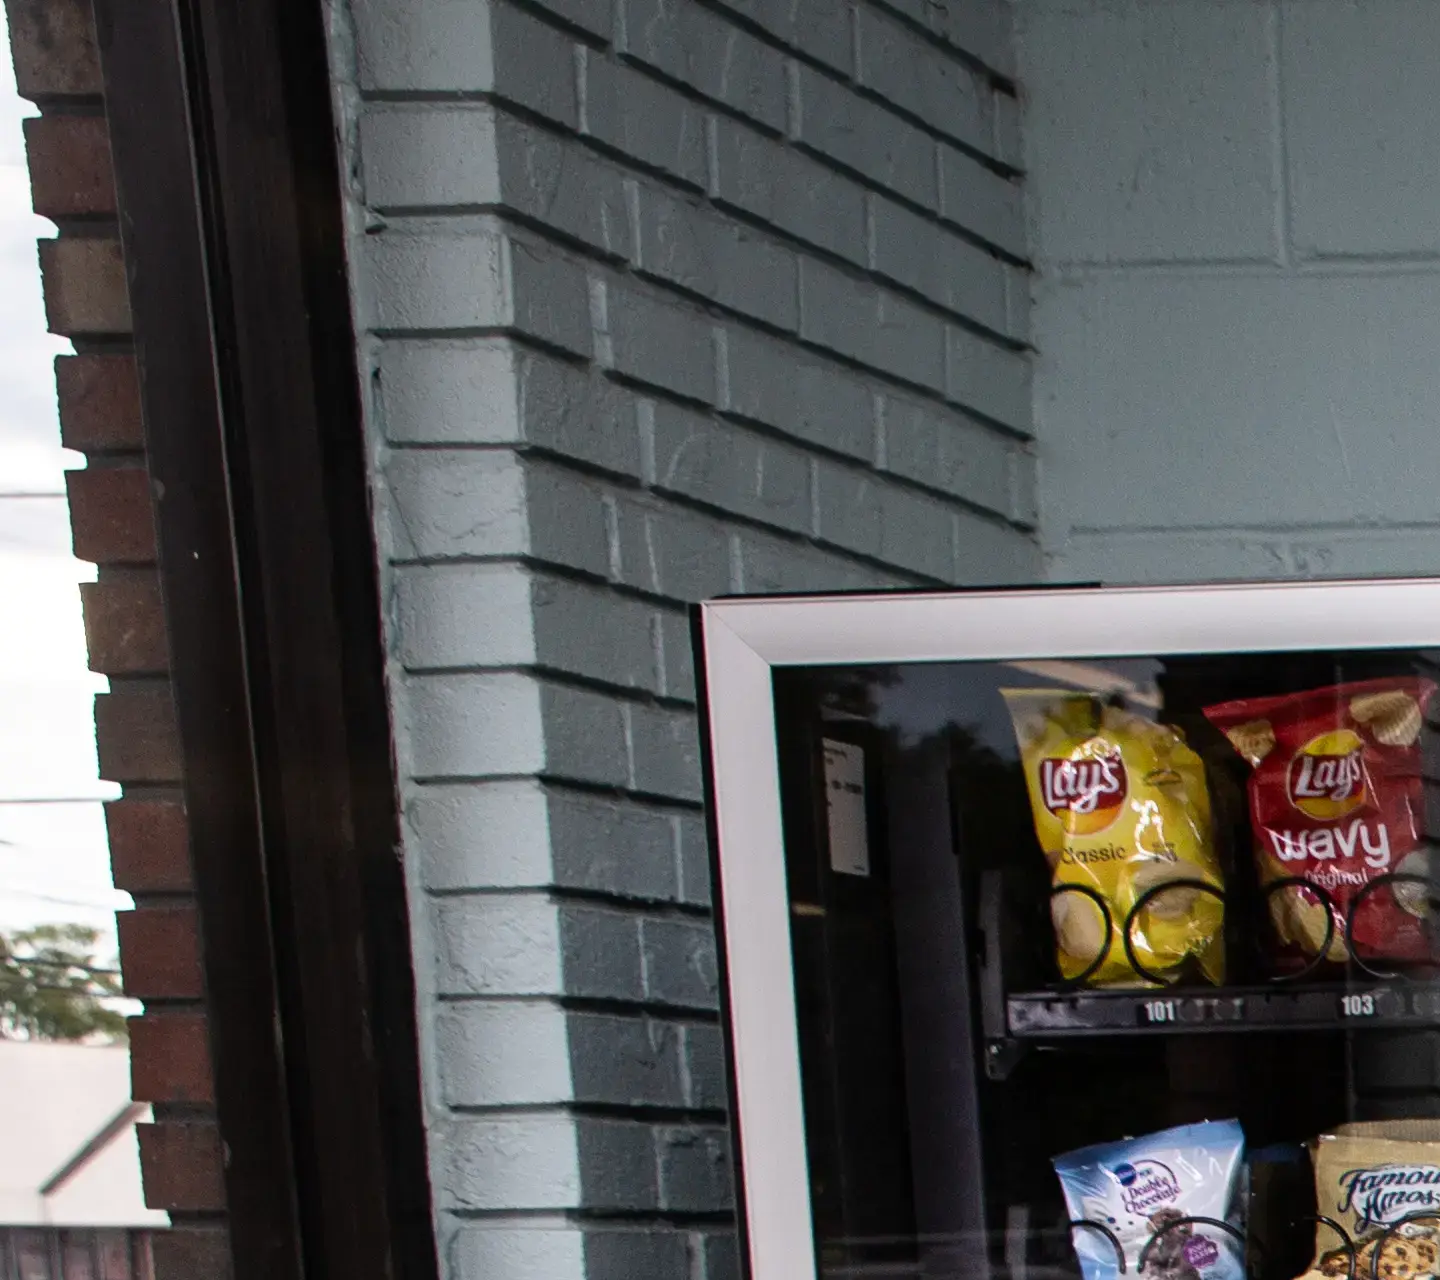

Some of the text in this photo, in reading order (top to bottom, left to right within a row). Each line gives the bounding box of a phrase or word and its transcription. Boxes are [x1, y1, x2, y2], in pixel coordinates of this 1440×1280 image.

[1062, 844, 1126, 865] Classic
[1145, 1001, 1174, 1022] 101
[1341, 995, 1373, 1016] 103
